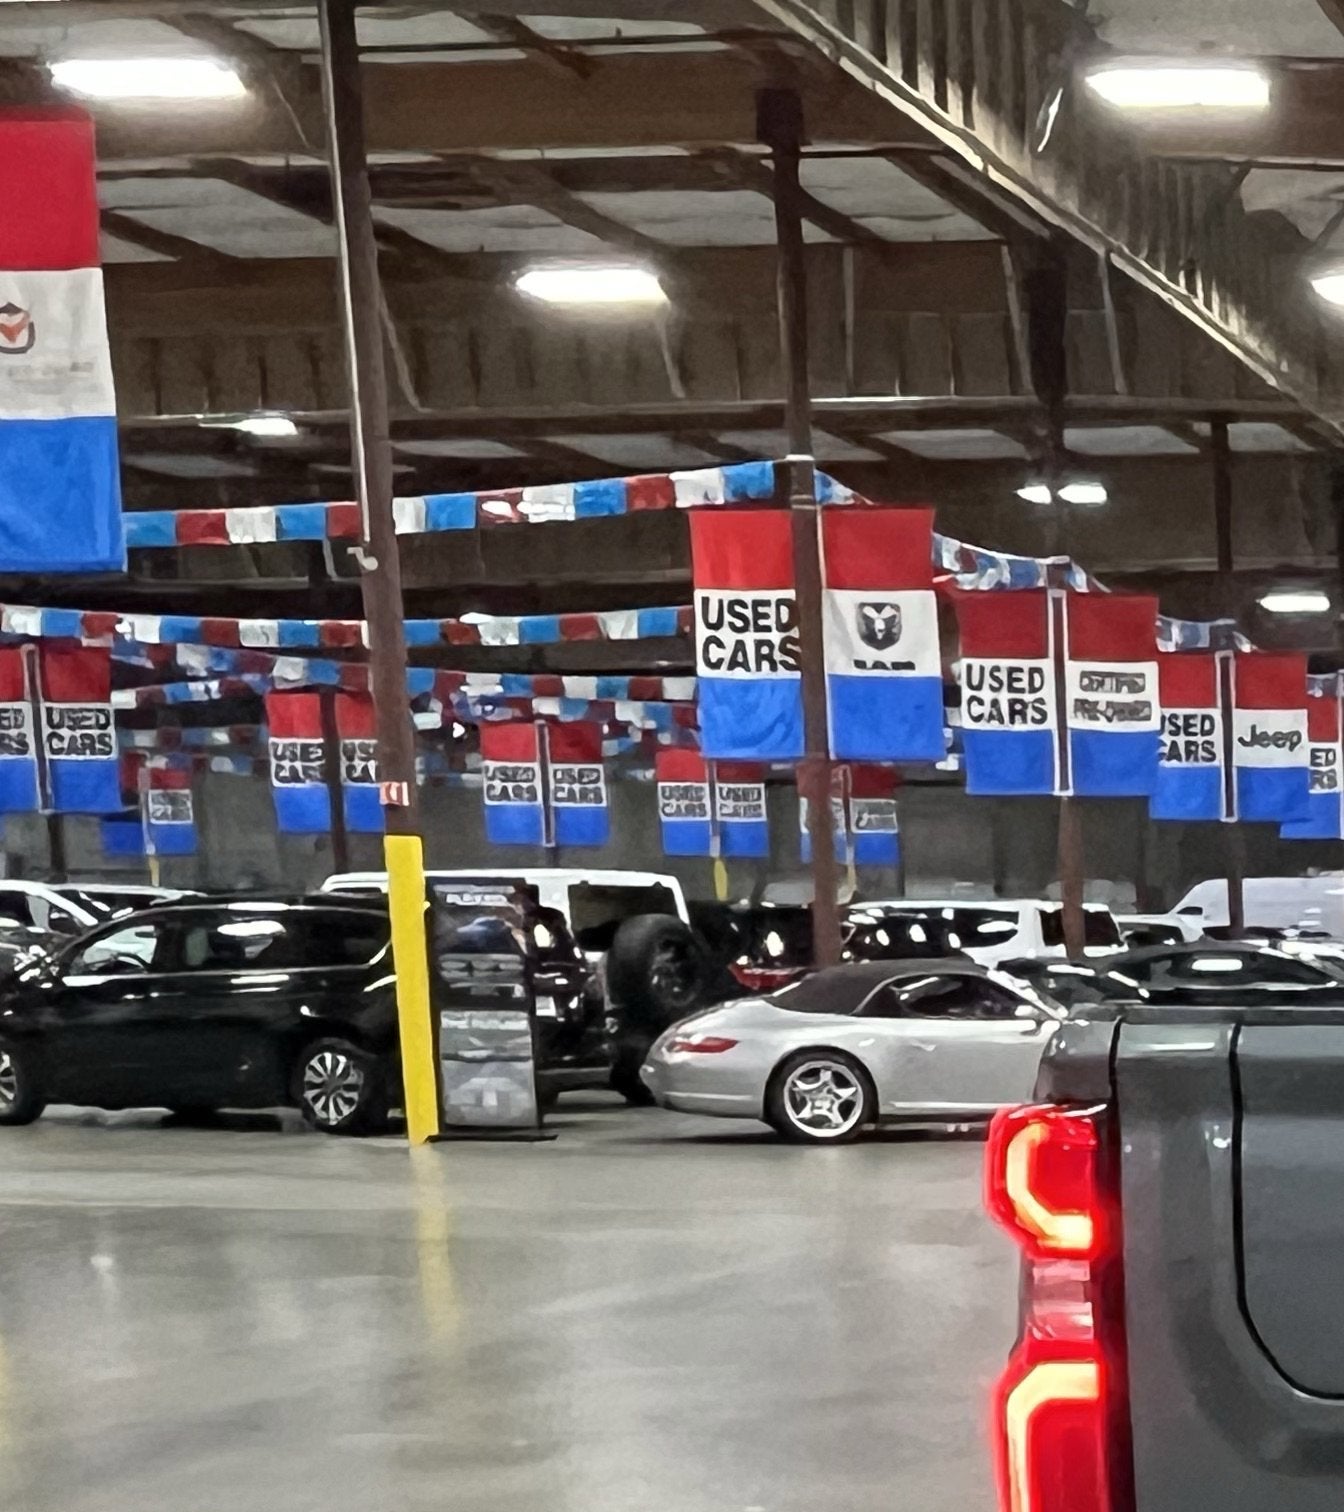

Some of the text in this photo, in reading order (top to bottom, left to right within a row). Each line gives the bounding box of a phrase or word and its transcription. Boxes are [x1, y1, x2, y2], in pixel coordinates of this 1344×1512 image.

[701, 596, 797, 633] USED
[702, 635, 801, 672] CARS
[966, 663, 1044, 693] USED
[967, 695, 1048, 724] CARS
[47, 732, 113, 755] CARS
[1159, 740, 1217, 762] ARS
[1237, 724, 1302, 752] Jeep
